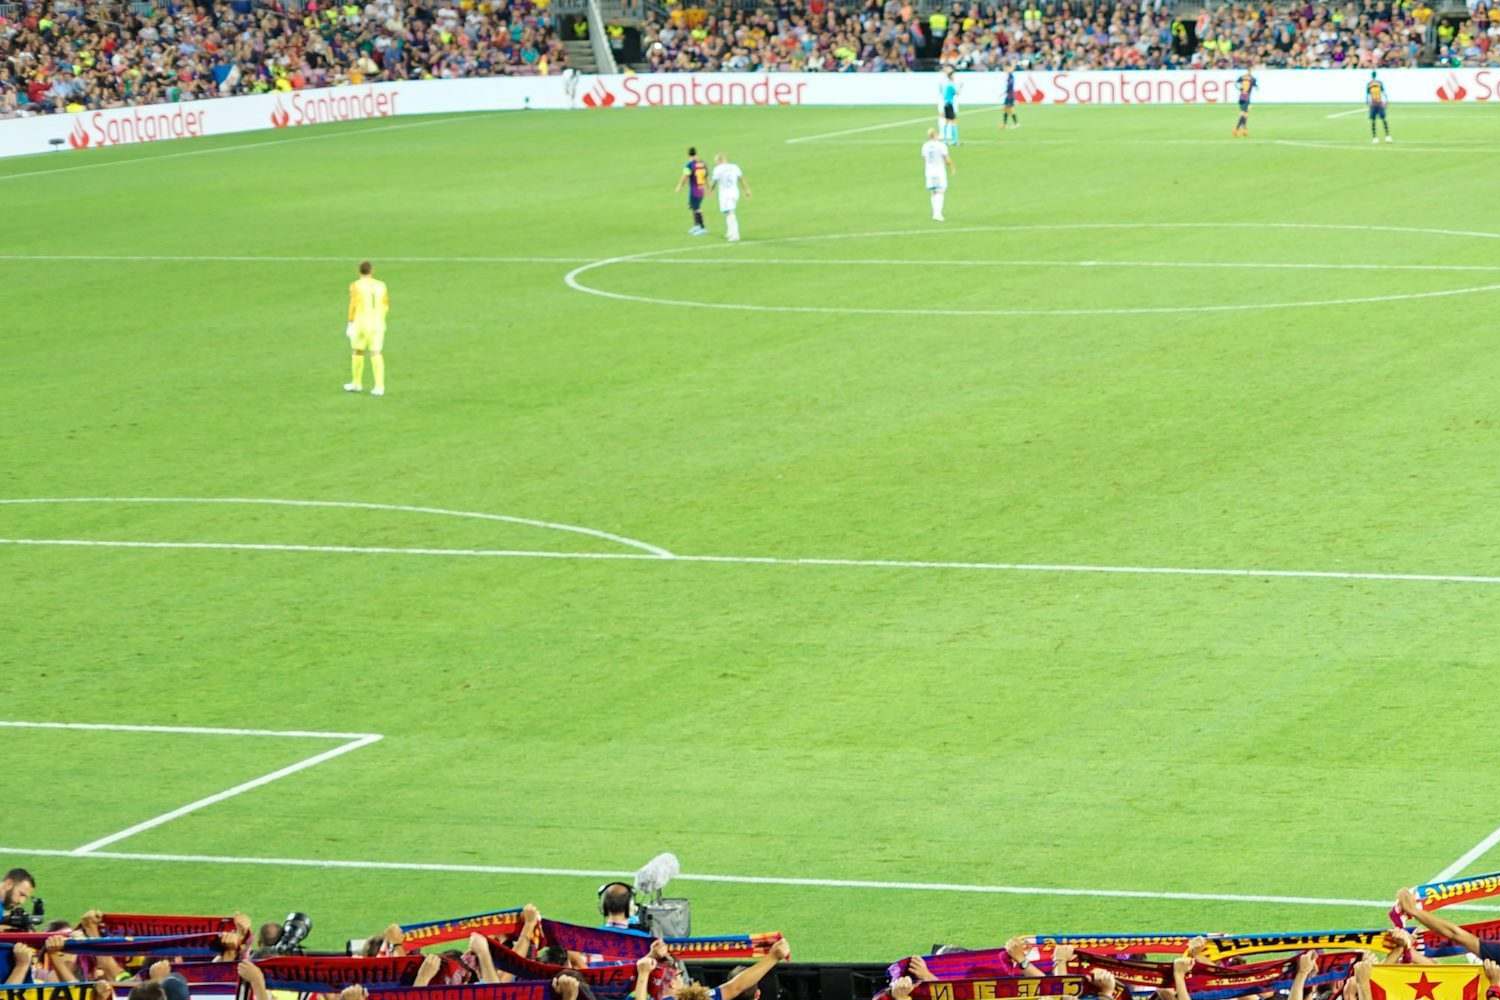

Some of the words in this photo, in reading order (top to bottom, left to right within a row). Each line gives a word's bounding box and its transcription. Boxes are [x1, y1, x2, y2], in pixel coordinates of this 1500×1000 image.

[623, 76, 807, 106] Santander
[1053, 73, 1236, 104] Santander
[291, 89, 399, 126] Santander
[91, 108, 205, 147] Santander
[1213, 932, 1377, 952] LLIBERTAT
